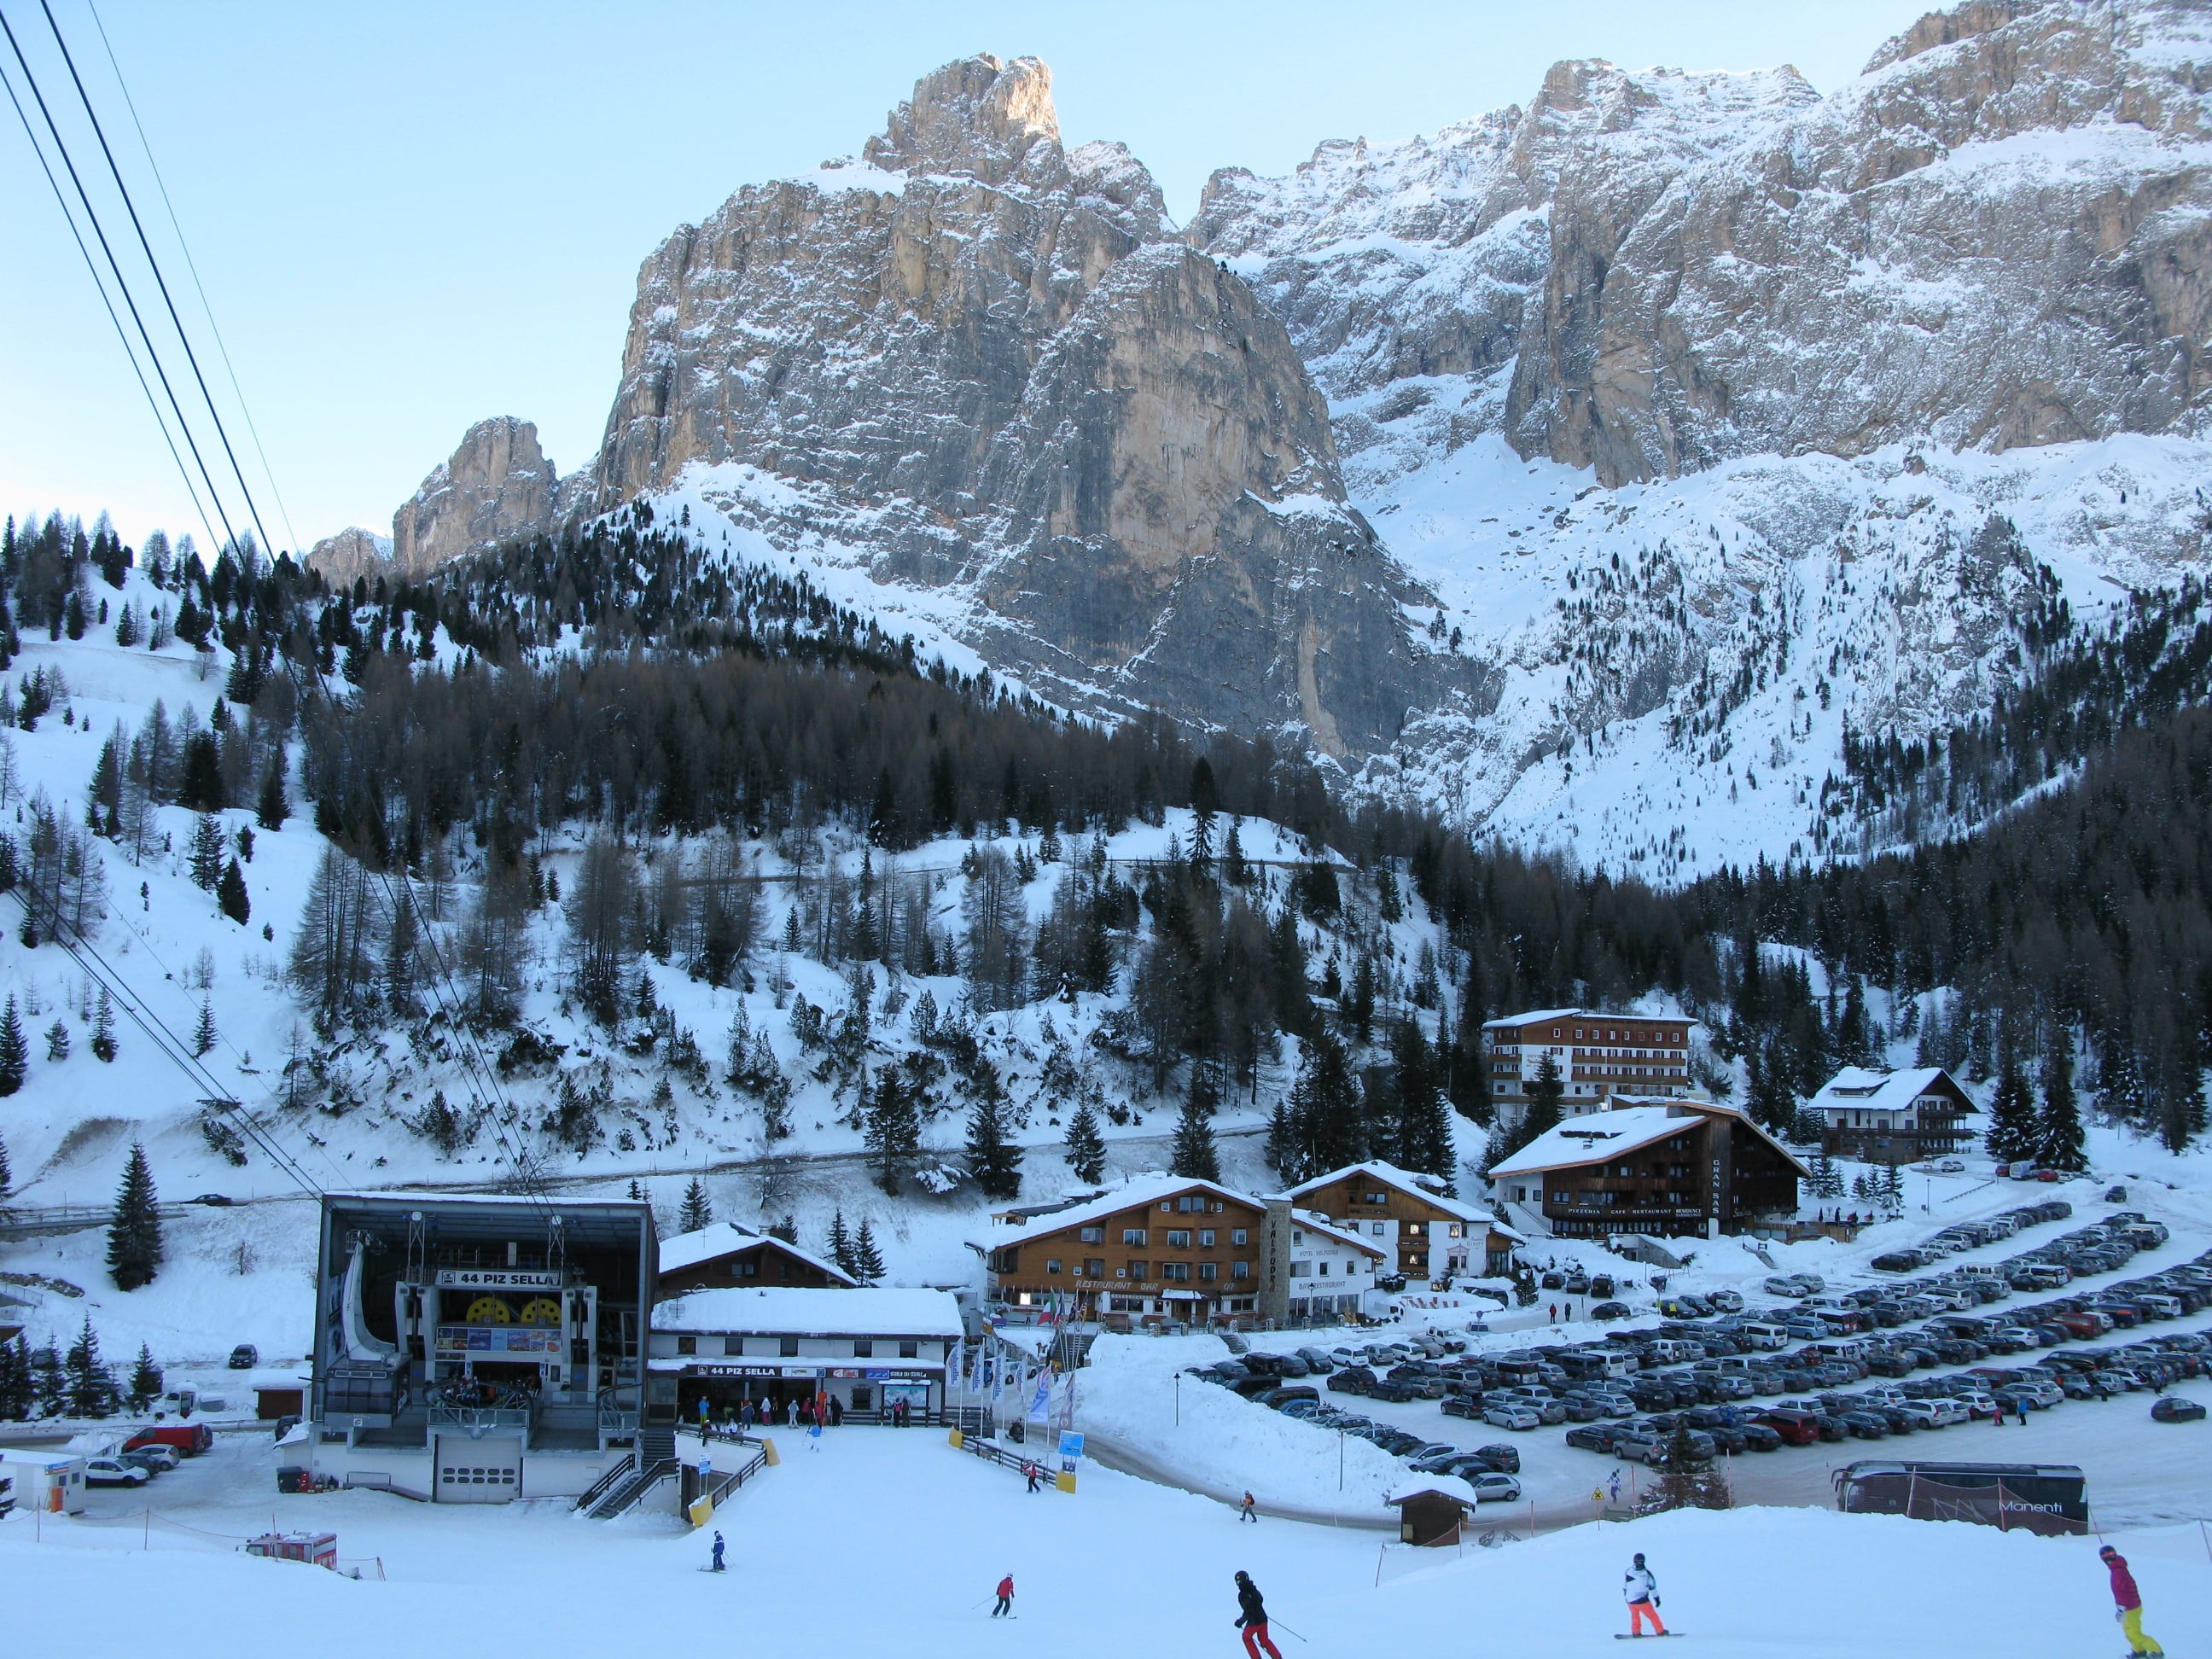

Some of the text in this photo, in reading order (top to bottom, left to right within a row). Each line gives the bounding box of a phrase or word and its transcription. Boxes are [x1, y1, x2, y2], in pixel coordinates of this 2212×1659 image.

[461, 1273, 479, 1283] 44
[483, 1274, 506, 1284] PIZ
[1075, 1280, 1132, 1289] RESTAURANT
[1140, 1282, 1159, 1290] BAR
[1999, 1500, 2063, 1513] Manenti
